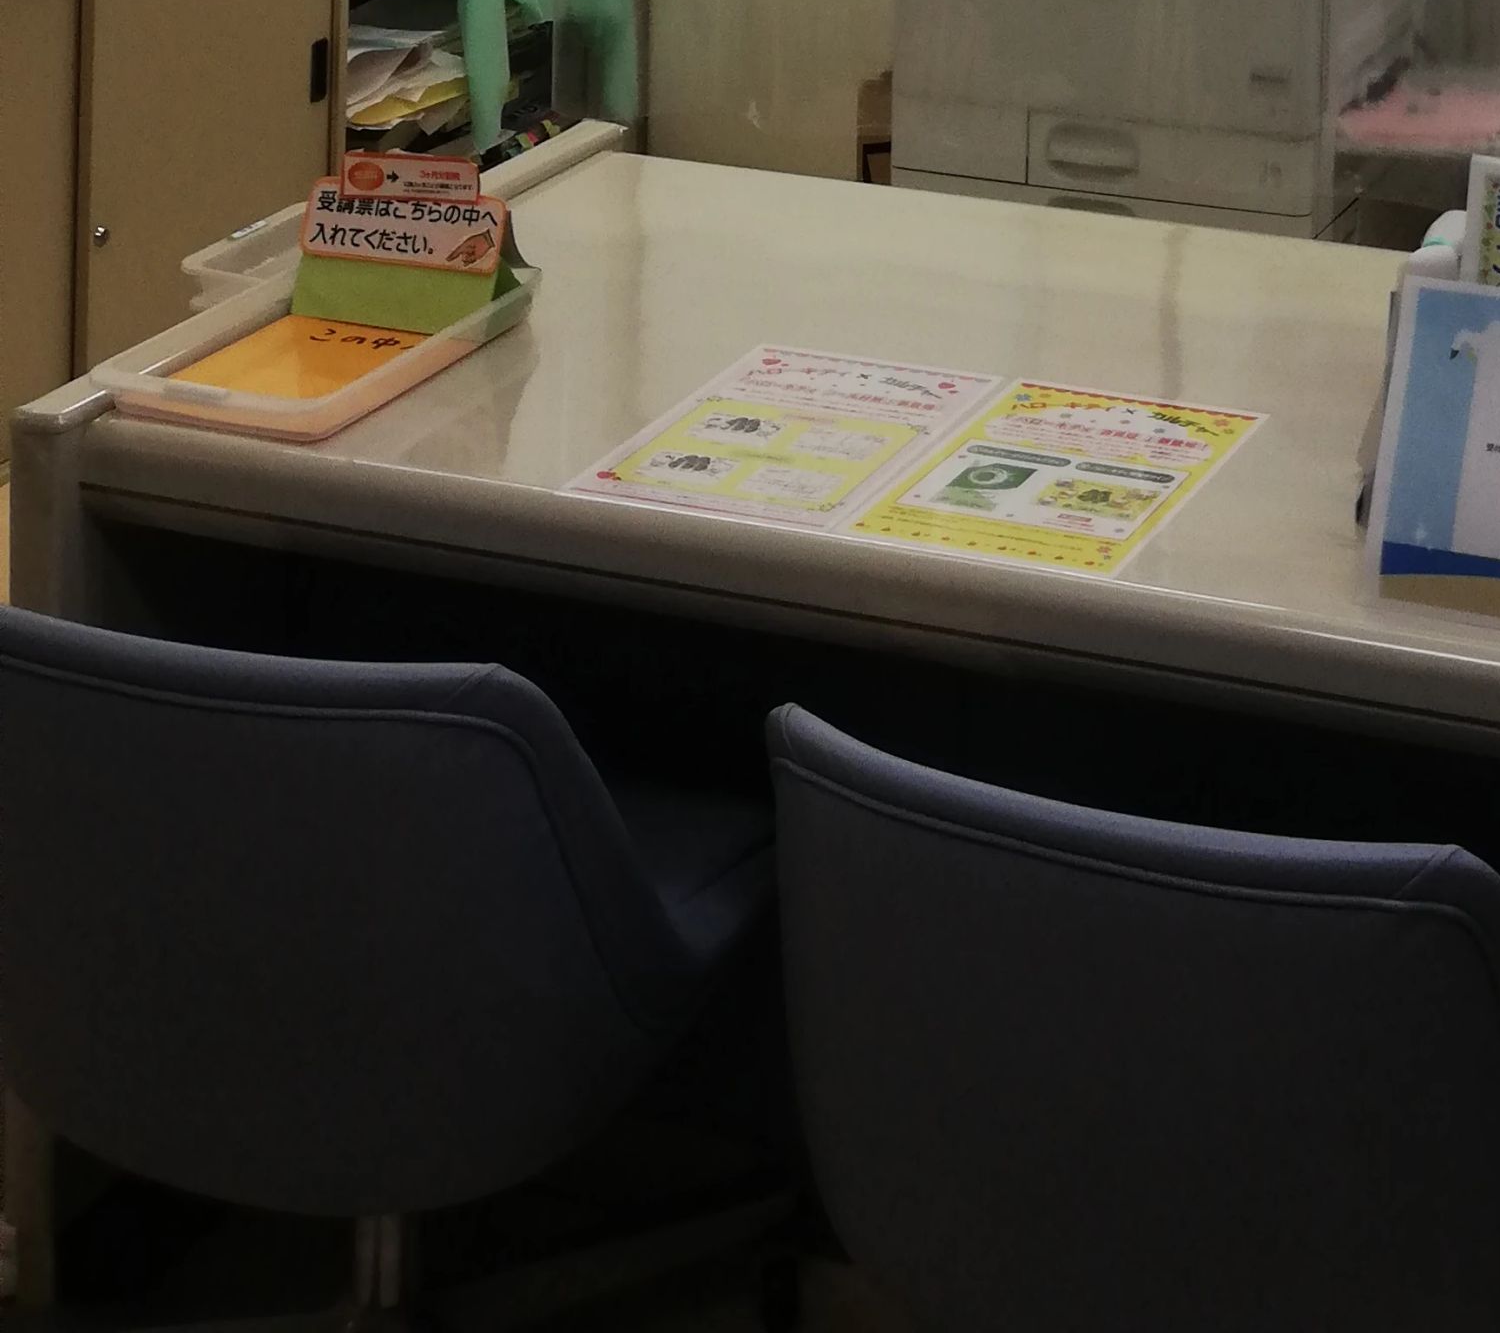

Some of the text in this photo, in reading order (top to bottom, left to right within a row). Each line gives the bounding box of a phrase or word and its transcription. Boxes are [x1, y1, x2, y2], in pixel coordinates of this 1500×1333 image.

[317, 190, 498, 227] 受講票はこちらの中へ
[309, 223, 434, 255] 入れてください。
